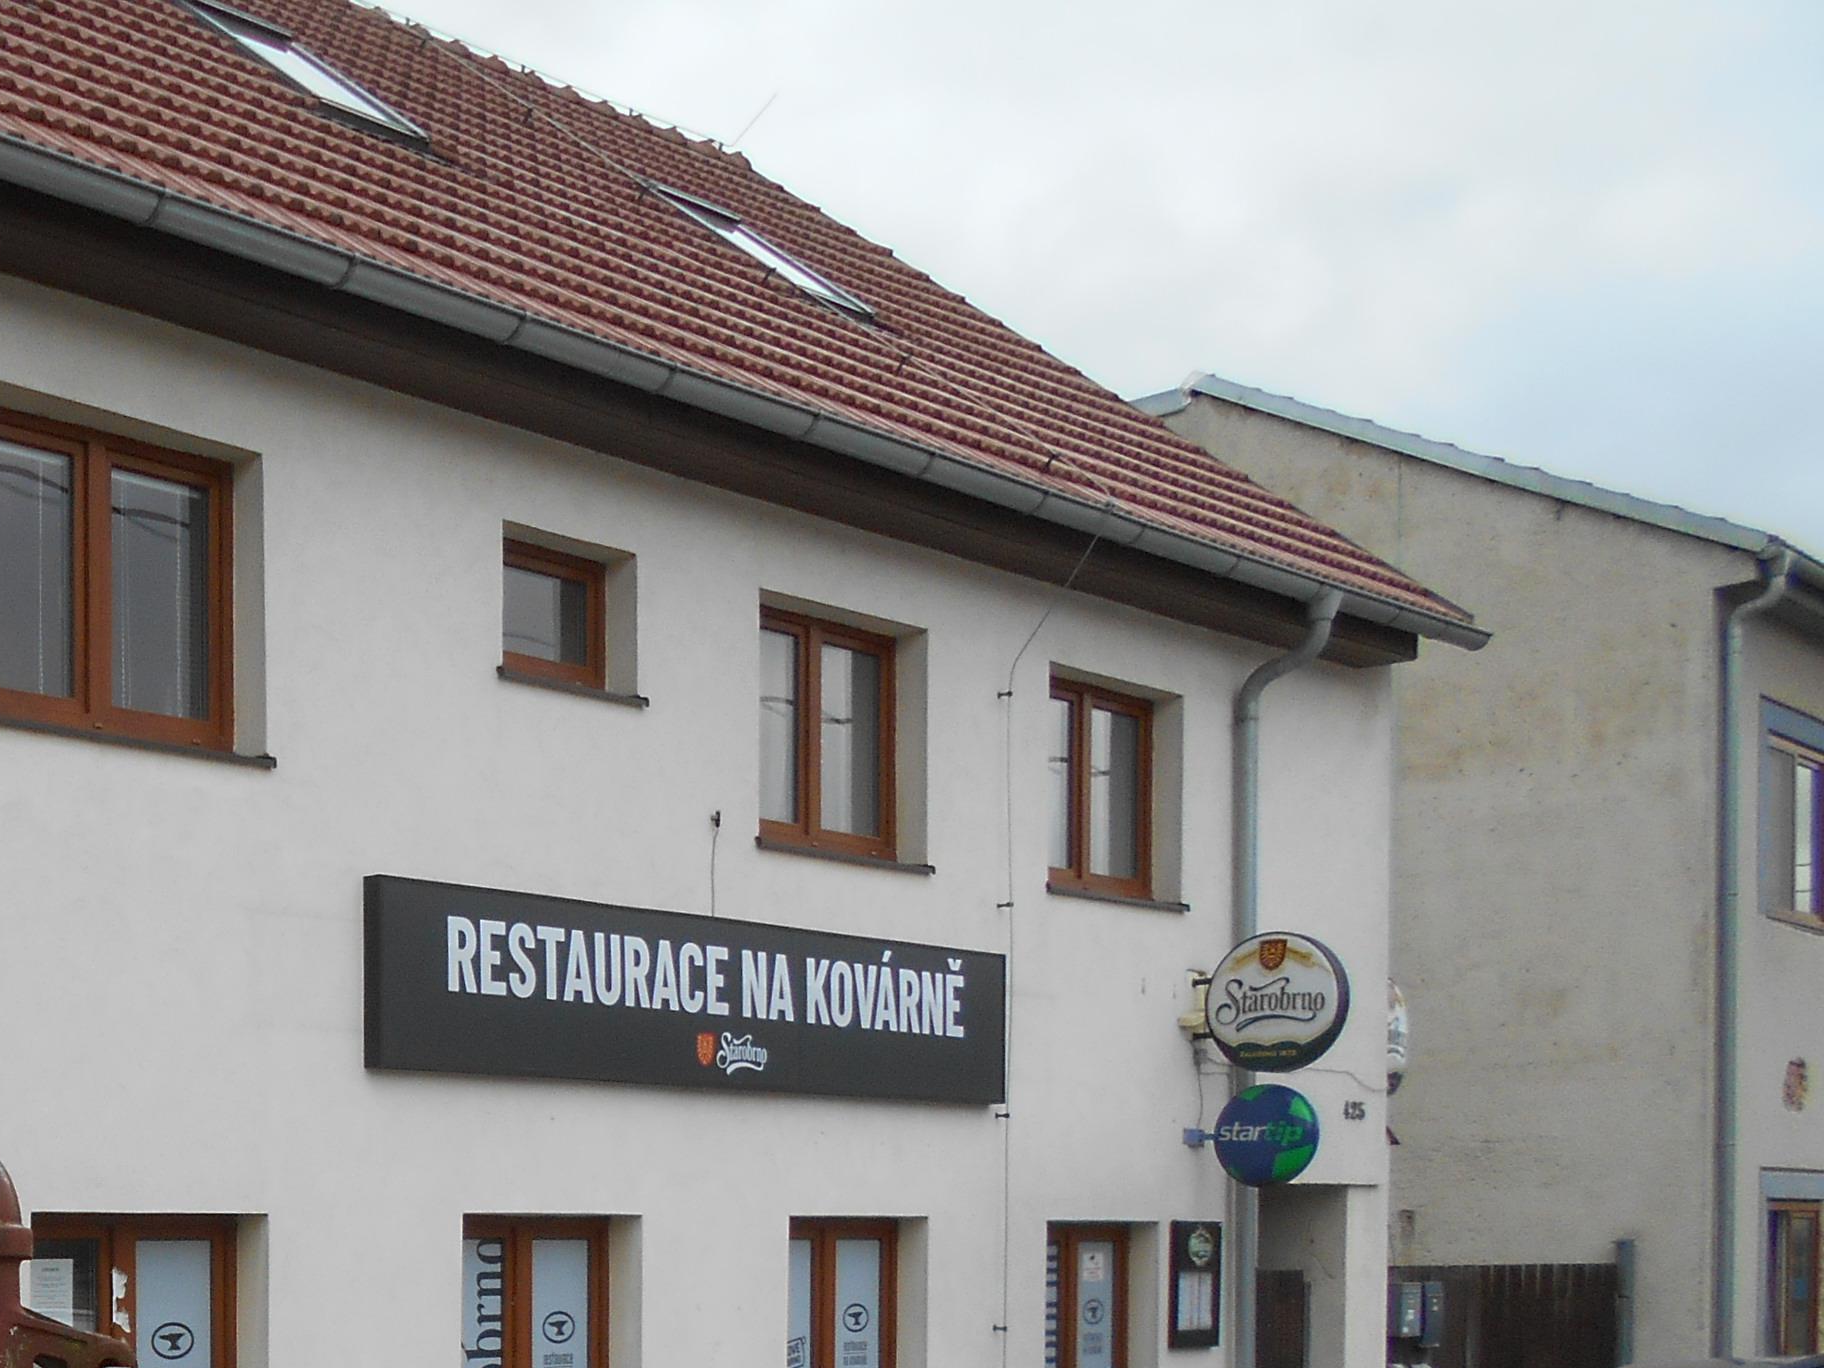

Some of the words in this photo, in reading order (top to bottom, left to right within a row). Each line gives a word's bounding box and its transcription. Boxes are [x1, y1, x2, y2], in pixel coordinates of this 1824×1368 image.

[447, 915, 730, 1016] RESTAURACE
[741, 949, 795, 1022] NA
[805, 950, 965, 1038] KOVÁRNĚ
[1215, 977, 1326, 1033] Starobrno
[716, 1032, 768, 1075] Starobrno
